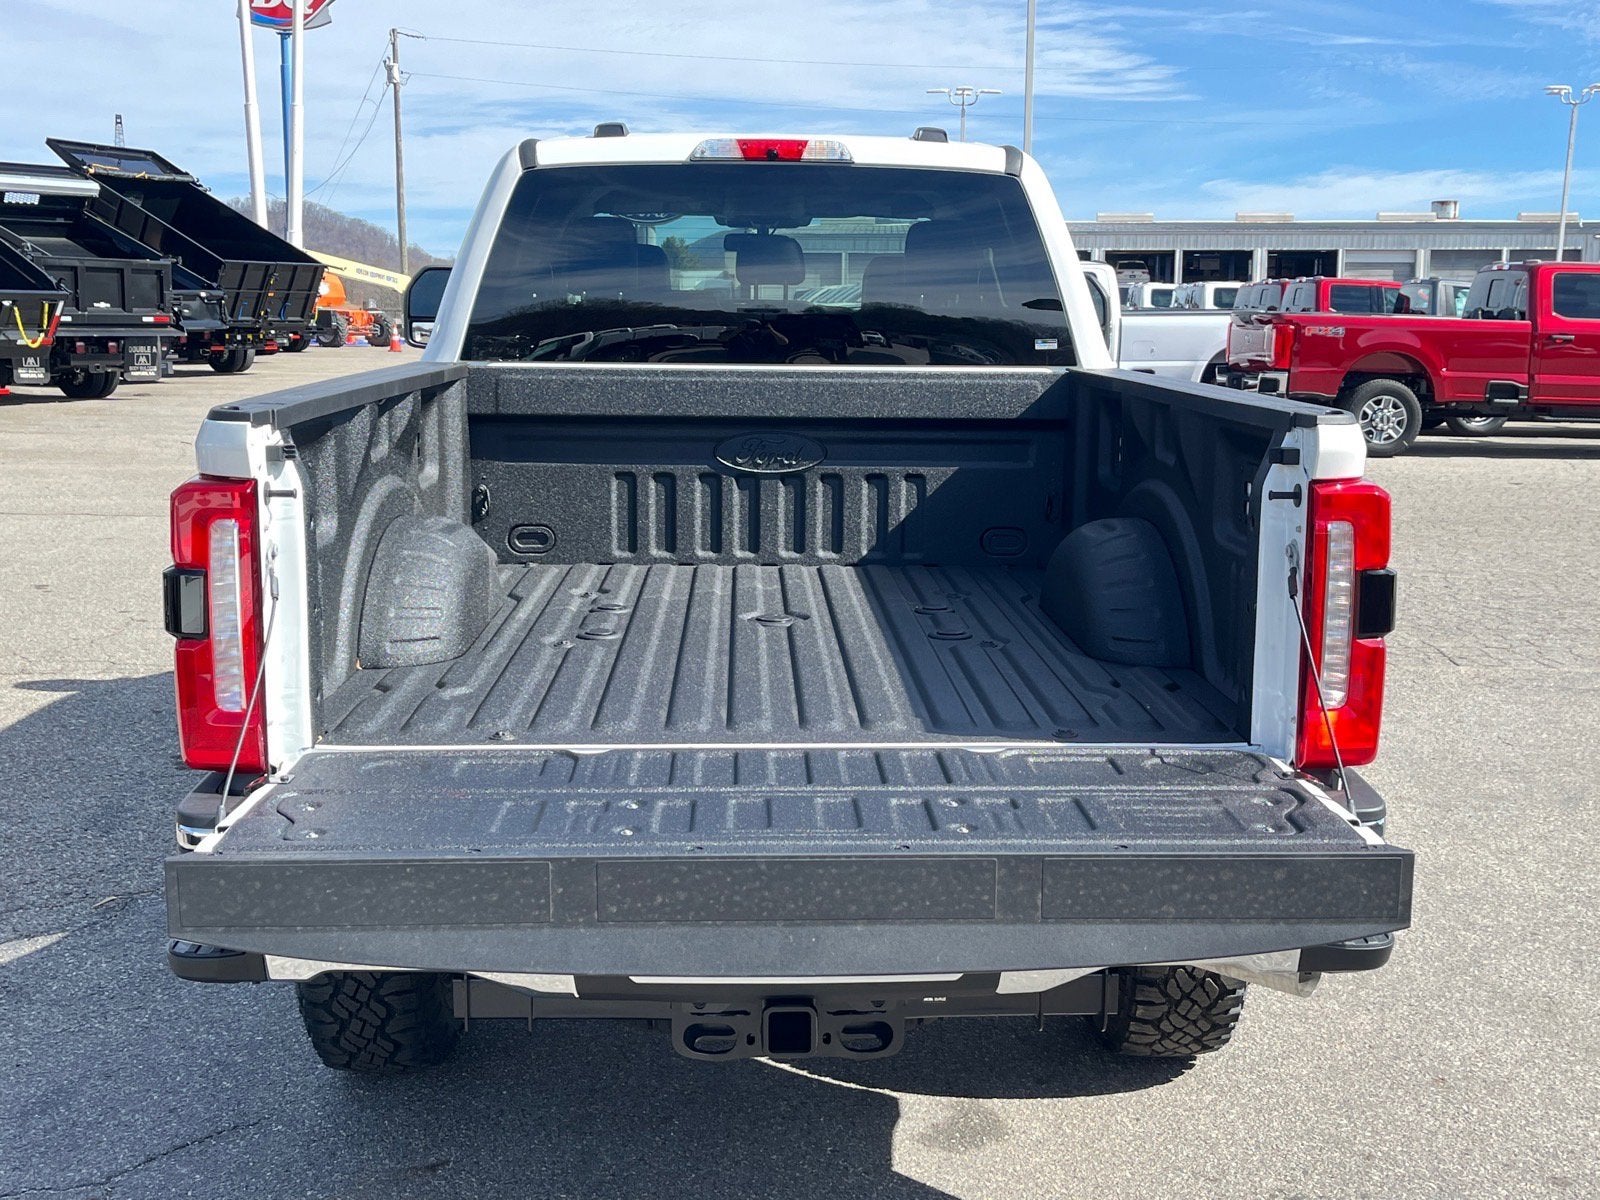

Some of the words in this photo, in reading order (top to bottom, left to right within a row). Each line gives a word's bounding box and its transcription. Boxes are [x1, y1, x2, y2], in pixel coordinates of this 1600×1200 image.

[1305, 326, 1345, 337] FX4
[128, 345, 152, 353] DOUBLE
[152, 345, 158, 353] A
[735, 437, 804, 465] Ford
